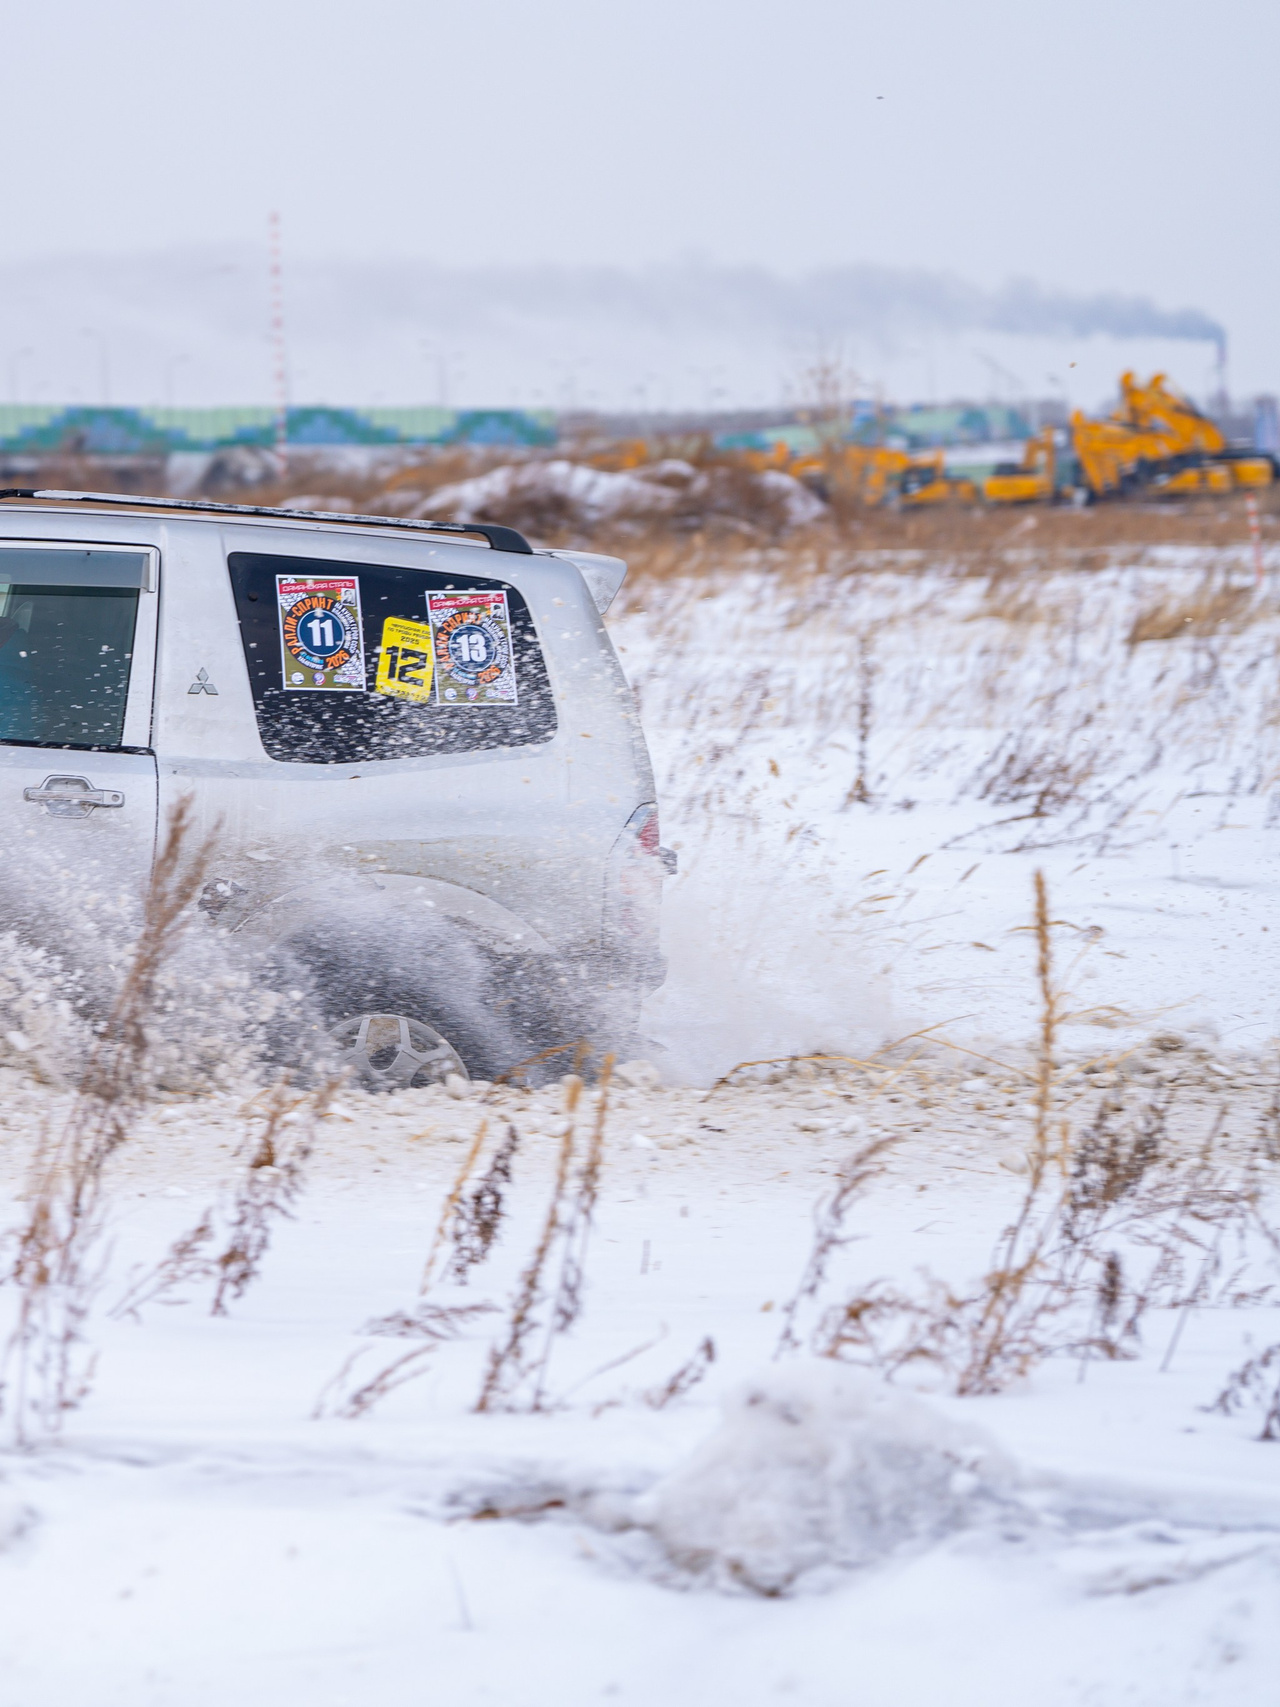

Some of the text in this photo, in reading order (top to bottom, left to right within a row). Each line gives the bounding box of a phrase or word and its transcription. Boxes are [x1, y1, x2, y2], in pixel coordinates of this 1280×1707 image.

[307, 619, 334, 647] 11
[400, 635, 420, 645] 2025
[326, 650, 350, 669] 2026
[456, 634, 487, 662] 13
[386, 645, 428, 687] 12
